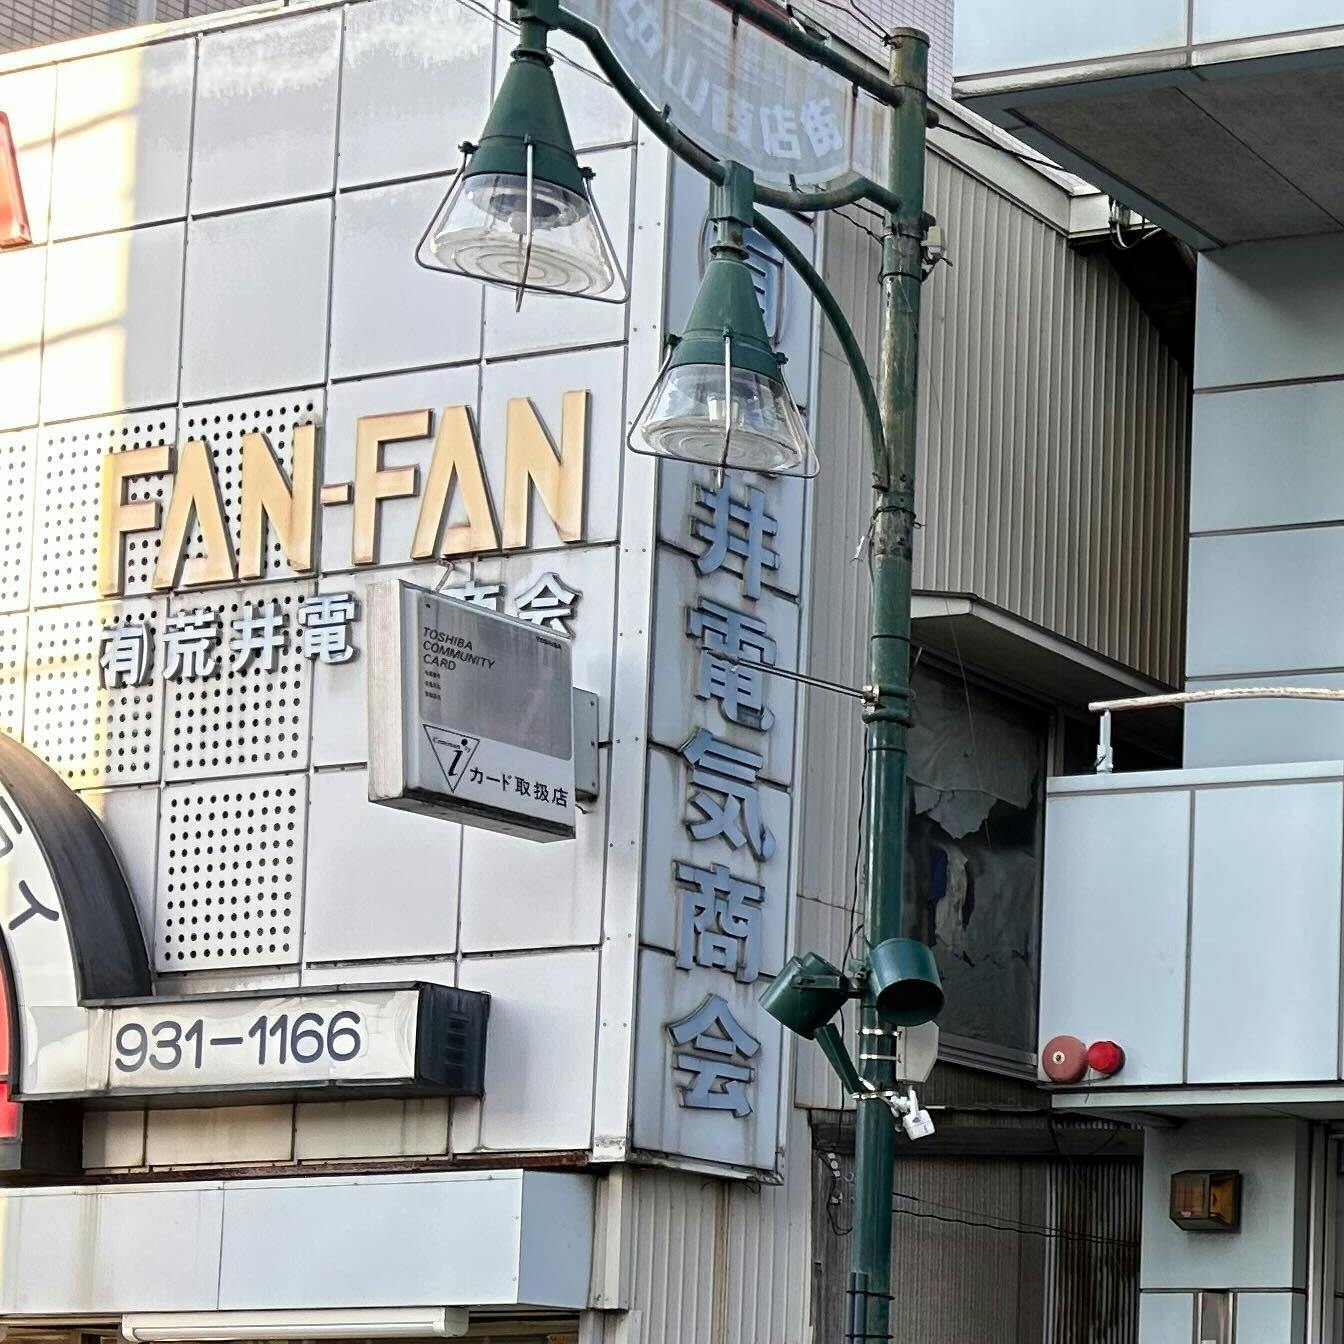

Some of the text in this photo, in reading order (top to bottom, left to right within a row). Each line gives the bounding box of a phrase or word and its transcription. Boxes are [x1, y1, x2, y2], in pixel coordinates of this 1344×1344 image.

[103, 389, 588, 596] FAN-FAN
[422, 626, 474, 651] TOSHIBA
[422, 640, 496, 669] COMMUNITY
[422, 653, 457, 672] CARD
[469, 766, 569, 808] カード取扱店
[114, 1010, 362, 1073] 931-1166
